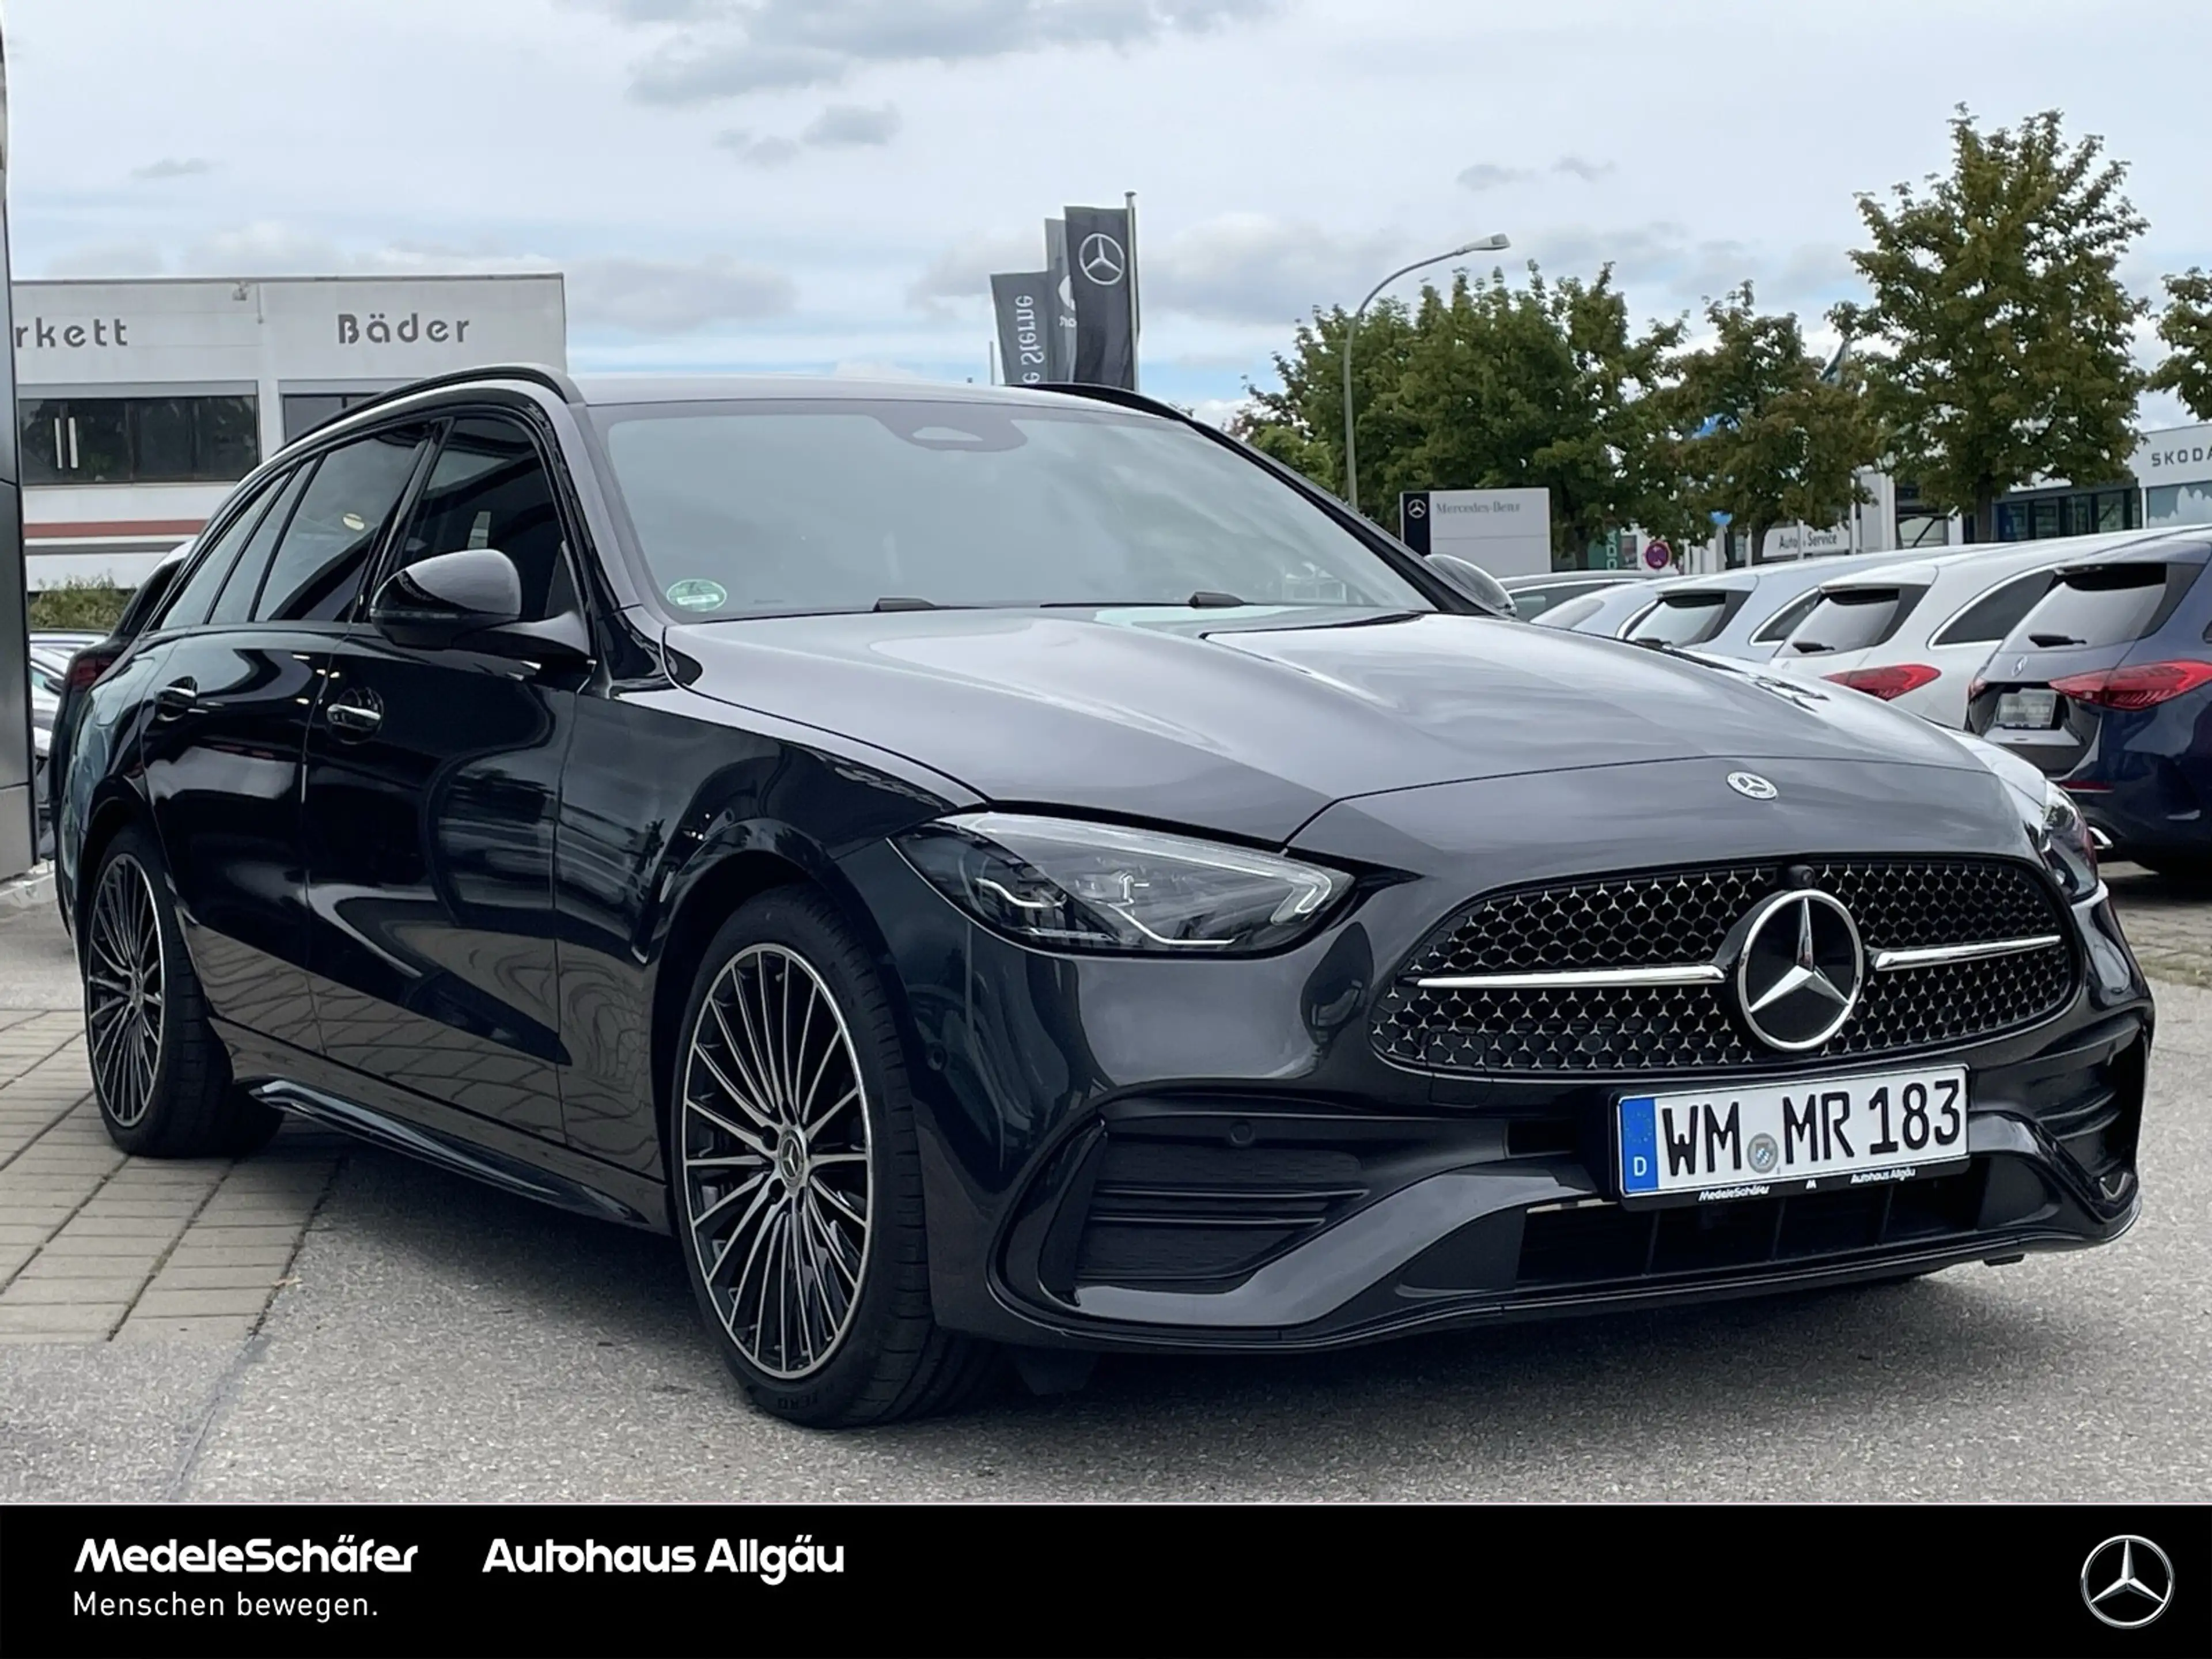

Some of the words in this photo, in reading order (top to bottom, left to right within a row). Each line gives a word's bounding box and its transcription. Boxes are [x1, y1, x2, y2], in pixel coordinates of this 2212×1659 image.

[16, 317, 128, 348] rkett
[338, 312, 469, 344] Bäder
[1436, 501, 1521, 514] Mercedes-Benz
[1807, 530, 1838, 547] Service
[1662, 1102, 1741, 1176] WM
[1783, 1092, 1855, 1164] MR
[1869, 1079, 1960, 1155] 183
[1634, 1157, 1647, 1176] D
